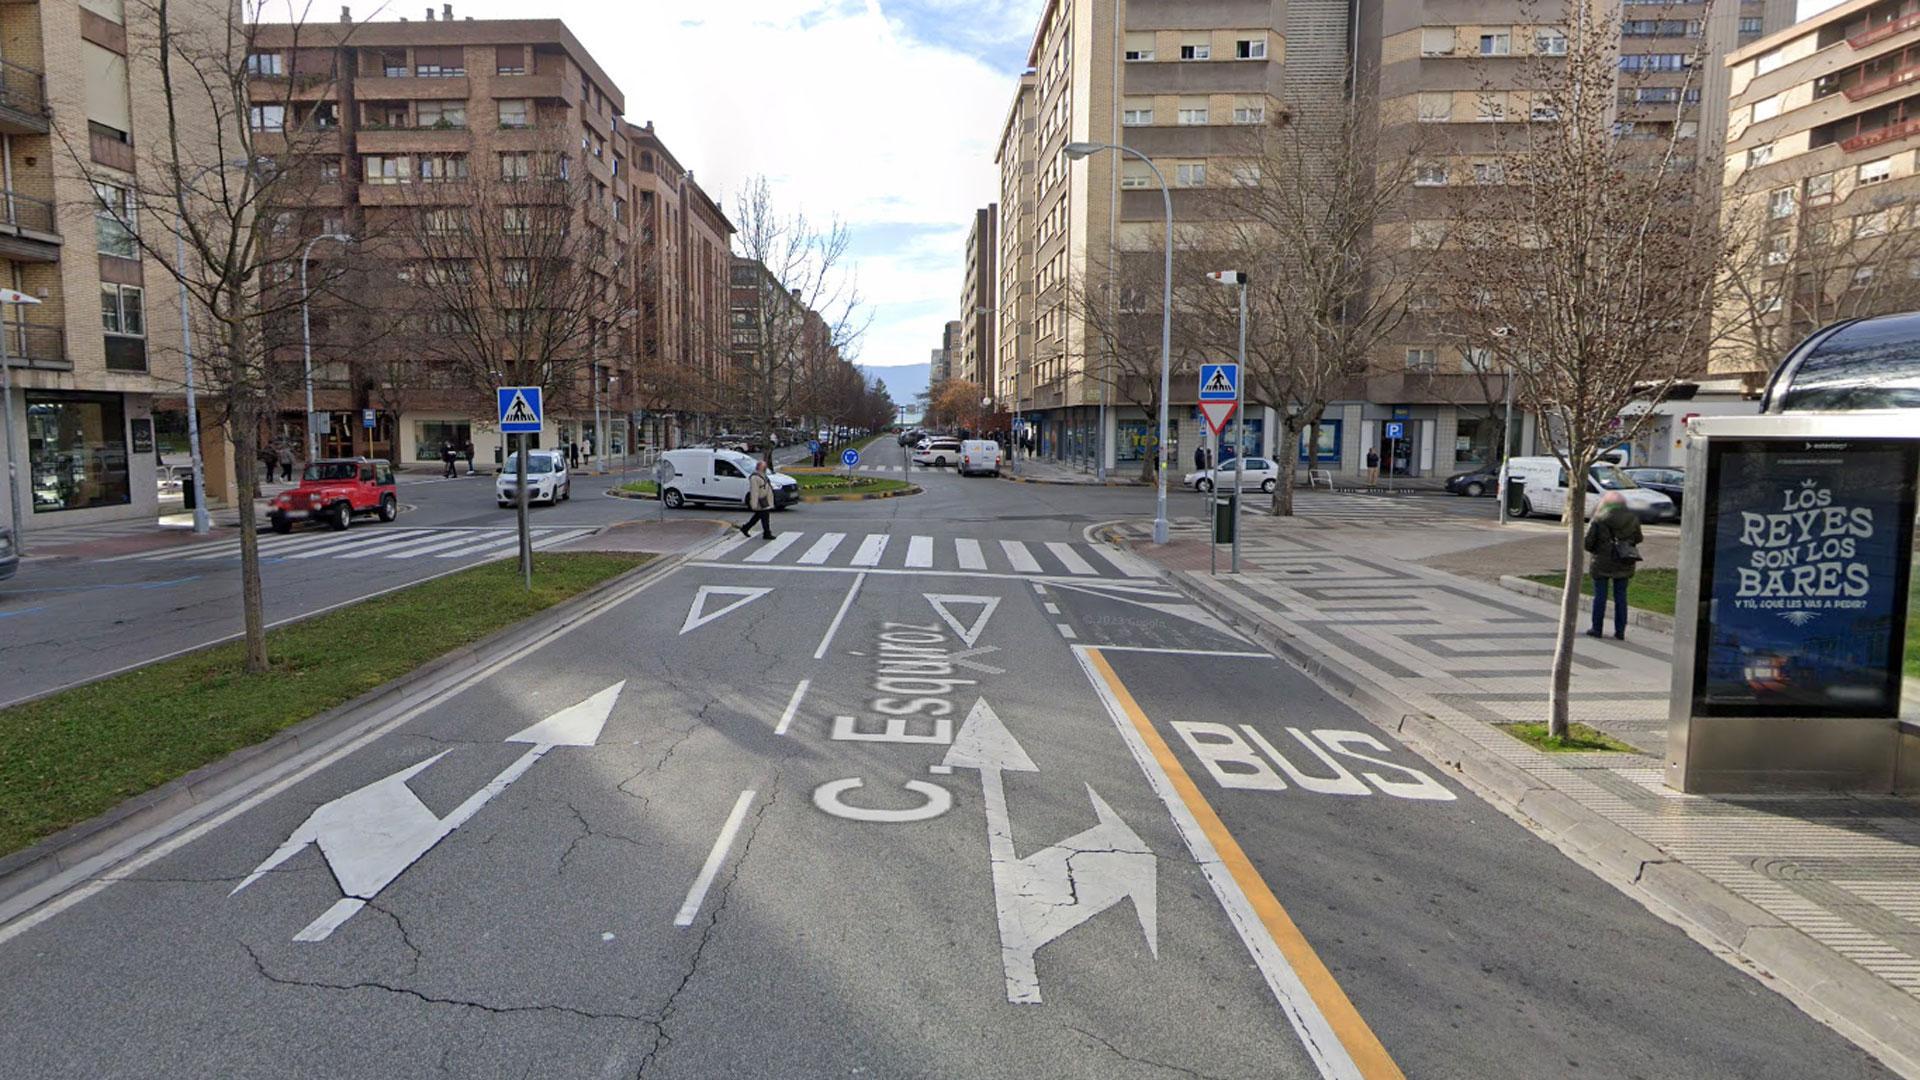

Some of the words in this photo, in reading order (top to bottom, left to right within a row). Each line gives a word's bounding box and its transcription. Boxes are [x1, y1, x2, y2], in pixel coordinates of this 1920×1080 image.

[1783, 489, 1832, 511] LOS
[1739, 506, 1874, 548] REYES
[1751, 546, 1800, 568] SON
[1806, 538, 1856, 562] LOS
[1736, 562, 1870, 597] BARES
[1734, 600, 1743, 608] Y
[1786, 600, 1801, 608] LES
[1804, 600, 1822, 608] VAS
[1823, 600, 1833, 608] A
[1834, 600, 1868, 608] PEDIR?
[1169, 720, 1458, 800] BUS
